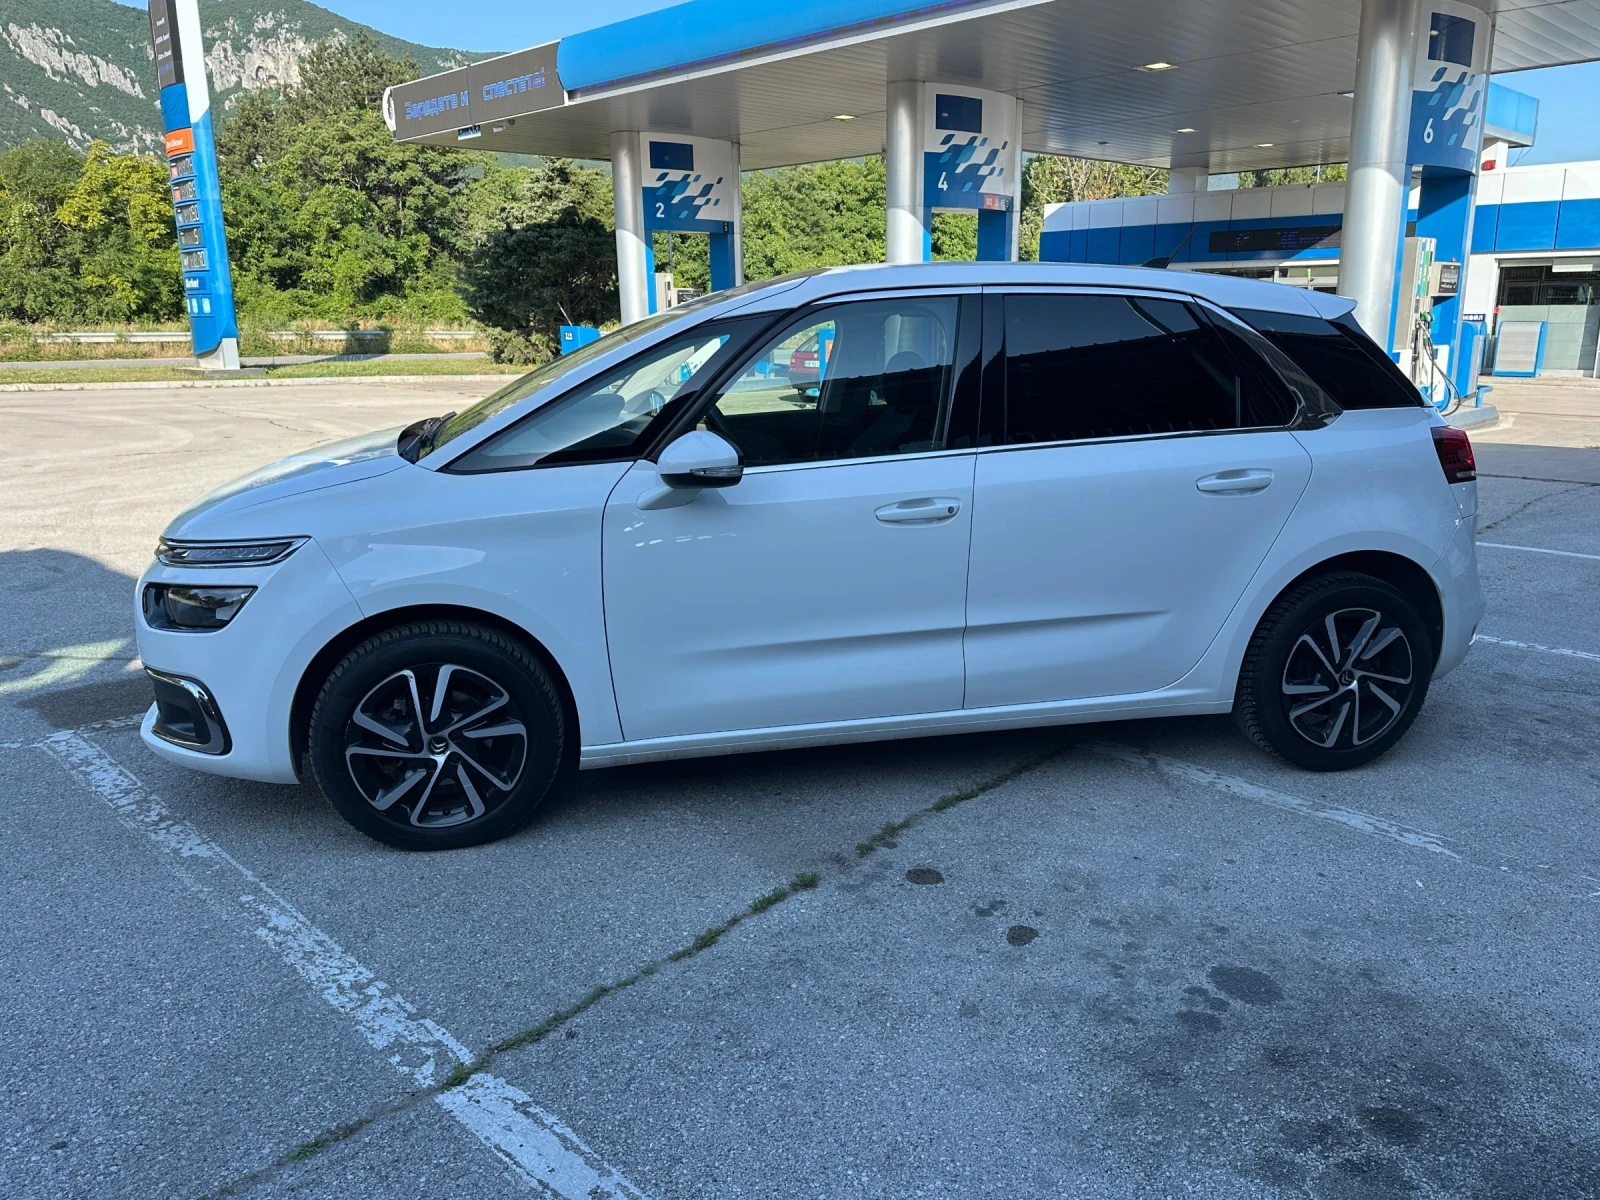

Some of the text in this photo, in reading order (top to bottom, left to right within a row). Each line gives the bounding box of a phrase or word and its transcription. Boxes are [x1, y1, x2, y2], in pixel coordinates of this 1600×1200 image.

[404, 93, 458, 120] Заредете
[1423, 117, 1434, 144] 6
[937, 171, 949, 192] 4
[655, 202, 665, 218] 2
